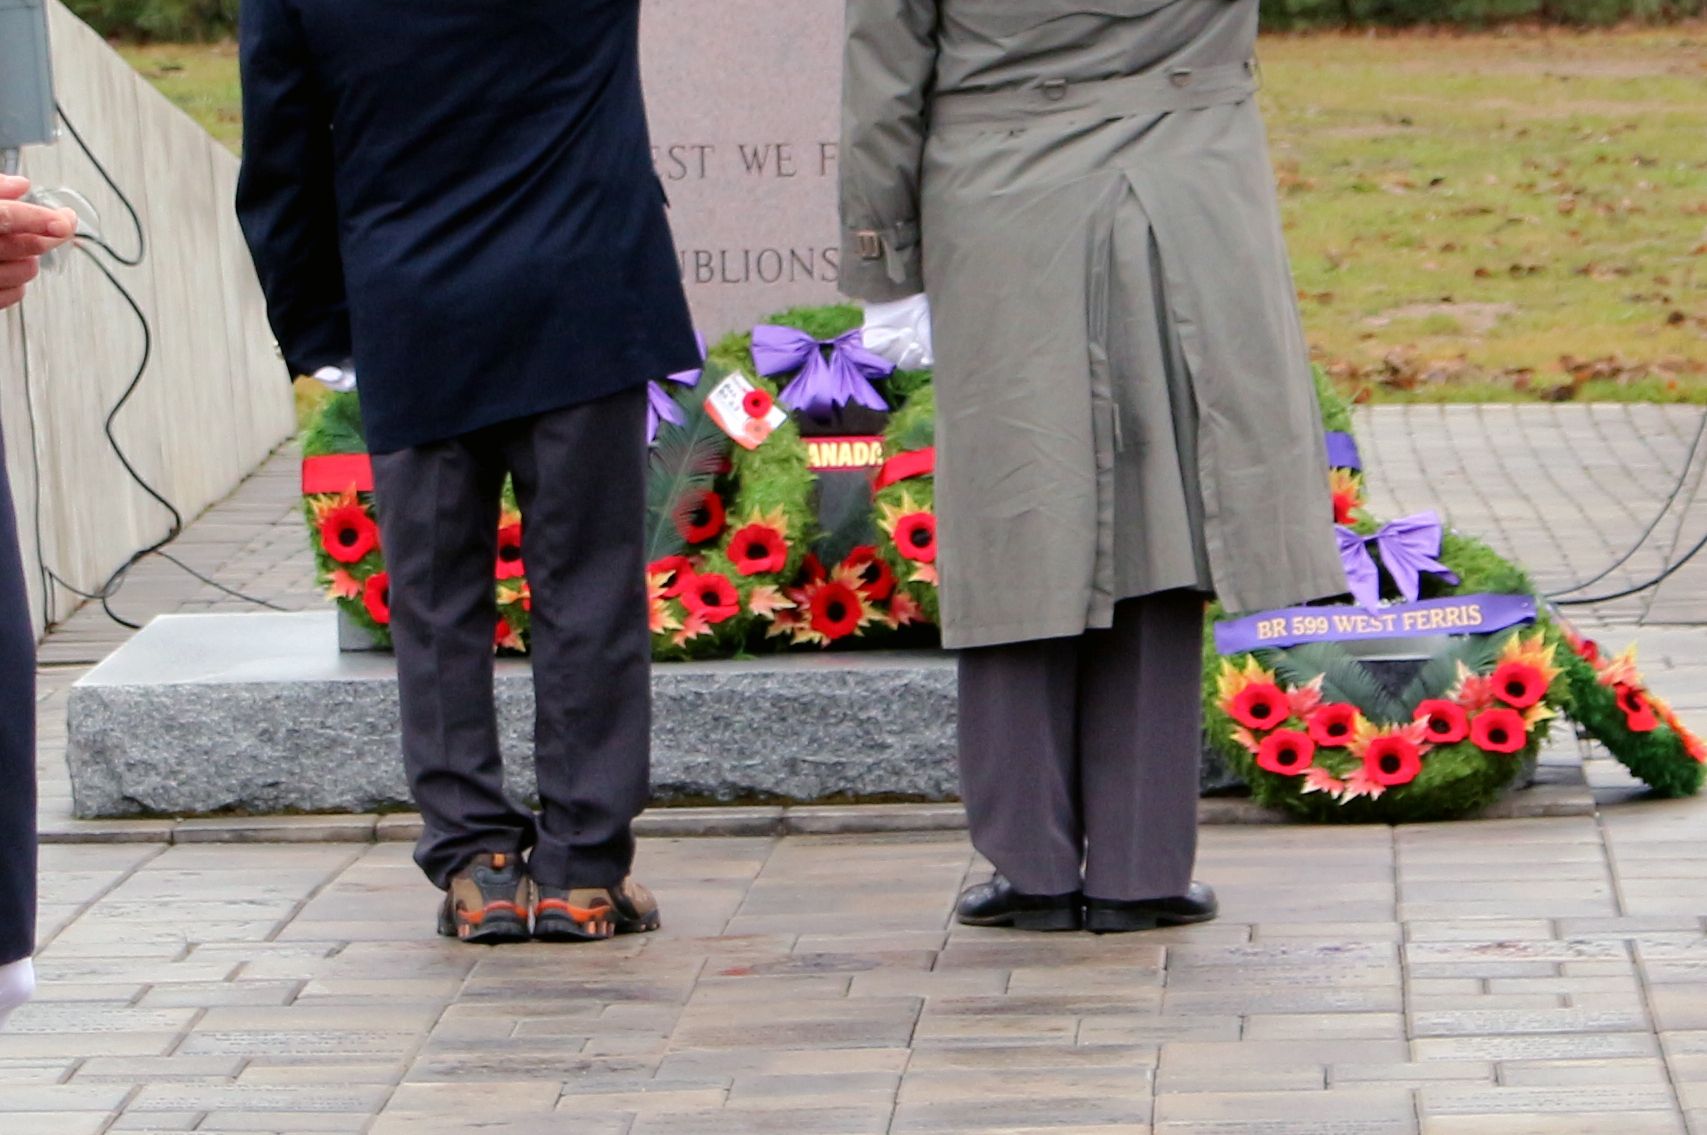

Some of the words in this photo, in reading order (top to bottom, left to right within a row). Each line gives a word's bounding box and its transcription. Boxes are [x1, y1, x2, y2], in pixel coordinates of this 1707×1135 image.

[650, 144, 716, 181] ST
[739, 142, 798, 178] WE
[680, 247, 840, 284] BLIONS
[807, 441, 884, 467] ANADA
[1257, 617, 1287, 641] BR
[1291, 616, 1328, 635] 599
[1331, 614, 1396, 634] WEST
[1402, 604, 1483, 631] FERRIS
